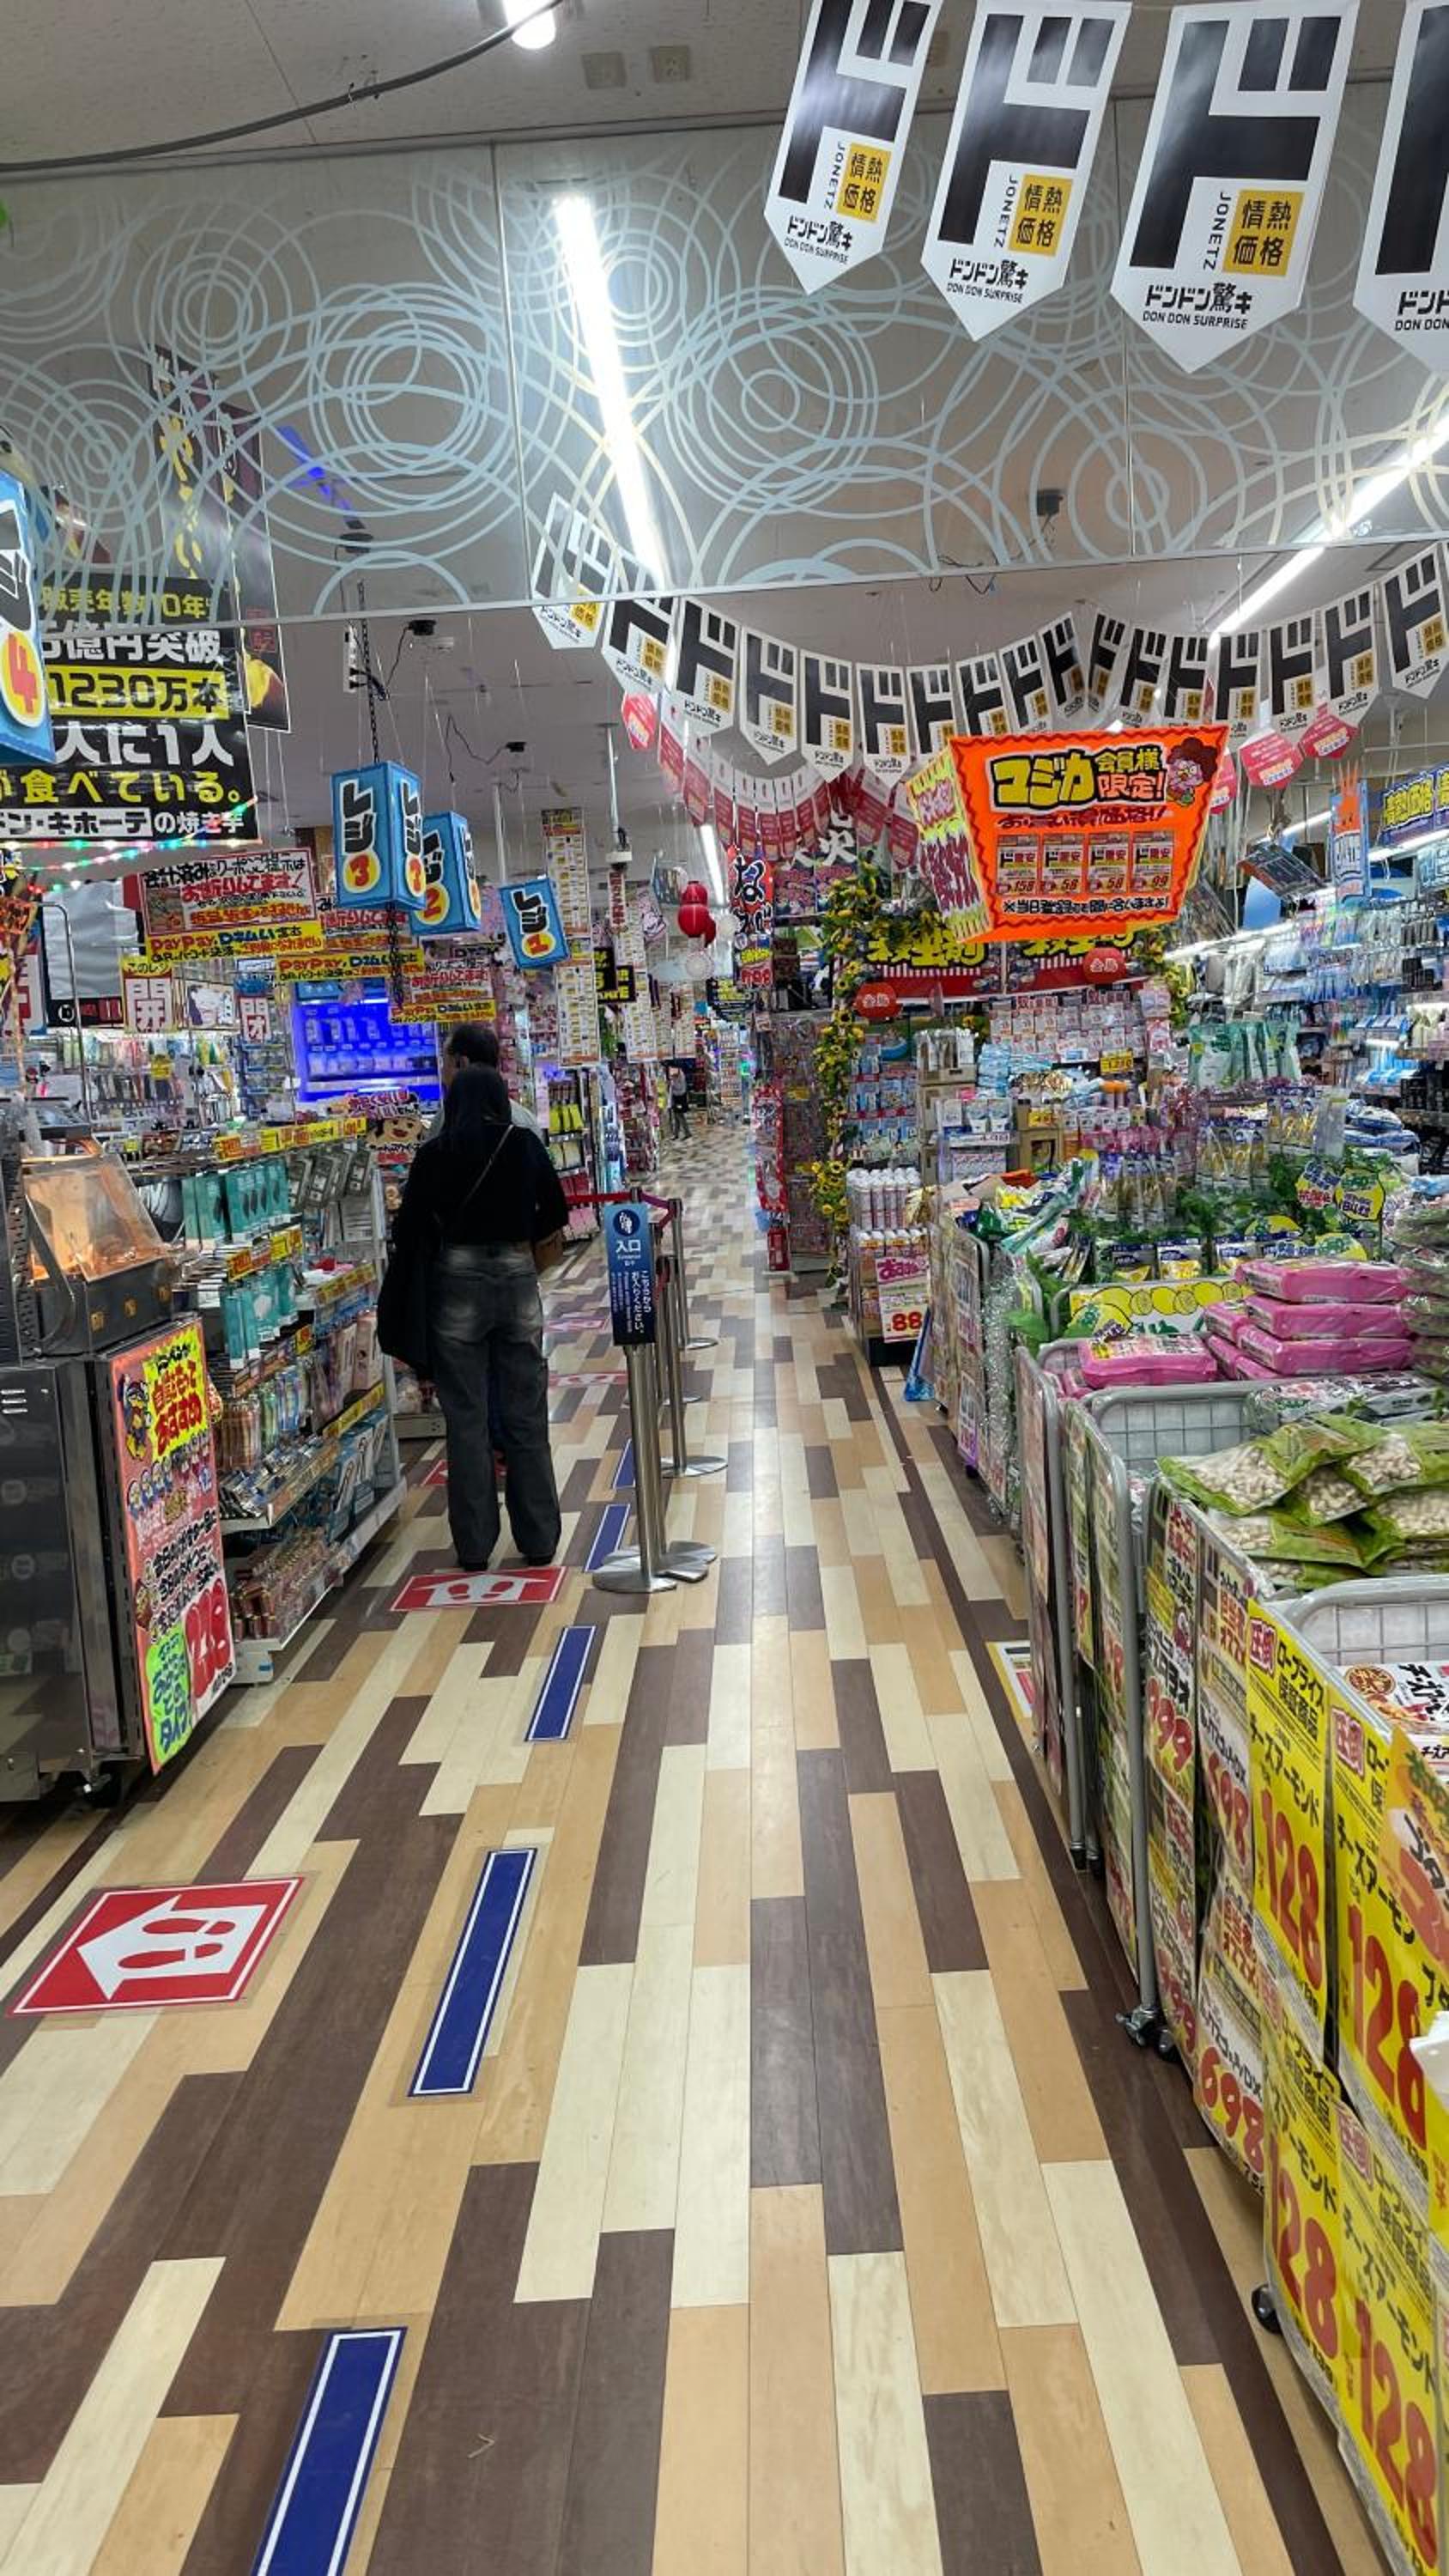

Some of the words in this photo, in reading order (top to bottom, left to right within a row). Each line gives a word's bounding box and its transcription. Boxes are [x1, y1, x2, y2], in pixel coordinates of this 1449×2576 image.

[824, 142, 845, 209] JONETZ
[850, 153, 882, 184] 情熱
[843, 183, 876, 214] 価格
[994, 174, 1018, 247] JONETZ
[1025, 184, 1063, 214] 情熱
[1242, 198, 1292, 231] 情熱
[787, 215, 852, 251] ドンドン驚キ
[1016, 216, 1057, 247] 価格
[1203, 191, 1231, 270] JONETZ
[785, 238, 799, 249] DON
[800, 242, 815, 254] DON
[815, 246, 849, 264] SURPRISE
[1233, 234, 1285, 267] 価格
[949, 258, 1028, 289] ドンドン驚キ
[947, 283, 964, 295] DON
[965, 285, 983, 298] DON
[984, 289, 1023, 303] SURPRISE
[1145, 282, 1252, 314] ドンドン驚キ
[1143, 310, 1165, 323] DON
[1167, 312, 1191, 325] DON
[1193, 314, 1248, 330] SURPRISE
[1395, 319, 1421, 331] DON
[343, 781, 375, 854] レジ
[349, 859, 372, 887] 3
[513, 890, 549, 934] レジ
[615, 1239, 642, 1254] 入口
[1277, 1641, 1325, 1712] ロープライス
[1250, 1710, 1321, 1829] チーズアーモンド
[1260, 1788, 1323, 1991] 128
[1348, 1904, 1428, 2150] 128
[1200, 2045, 1264, 2172] 698
[1356, 2299, 1437, 2567] 128
